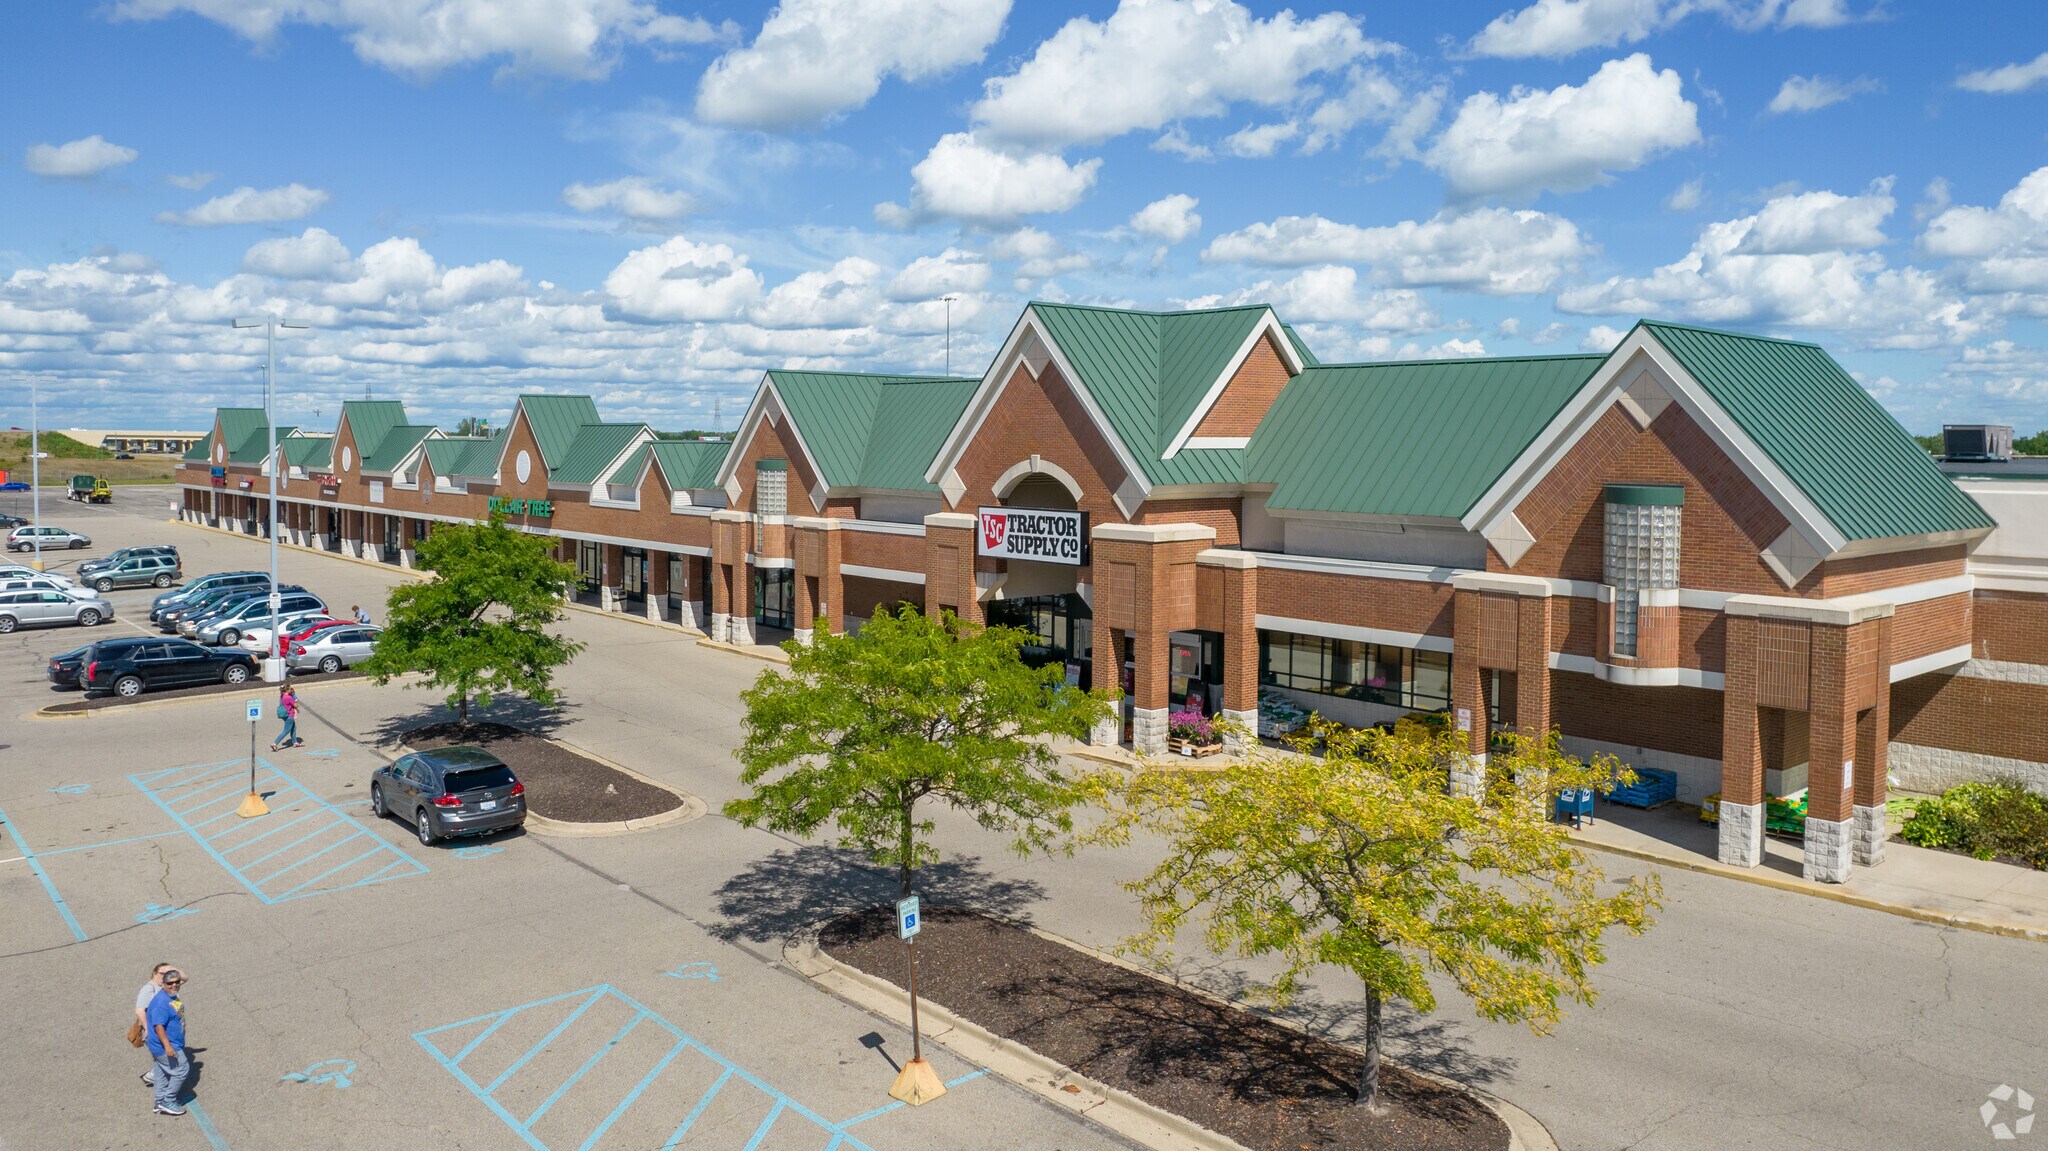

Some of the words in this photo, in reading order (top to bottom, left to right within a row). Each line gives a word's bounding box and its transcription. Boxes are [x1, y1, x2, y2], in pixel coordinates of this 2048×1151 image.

[527, 499, 550, 518] TREE
[984, 515, 1002, 543] TSC
[1007, 514, 1078, 537] TRACTOR
[1007, 534, 1060, 557] SUPPLY
